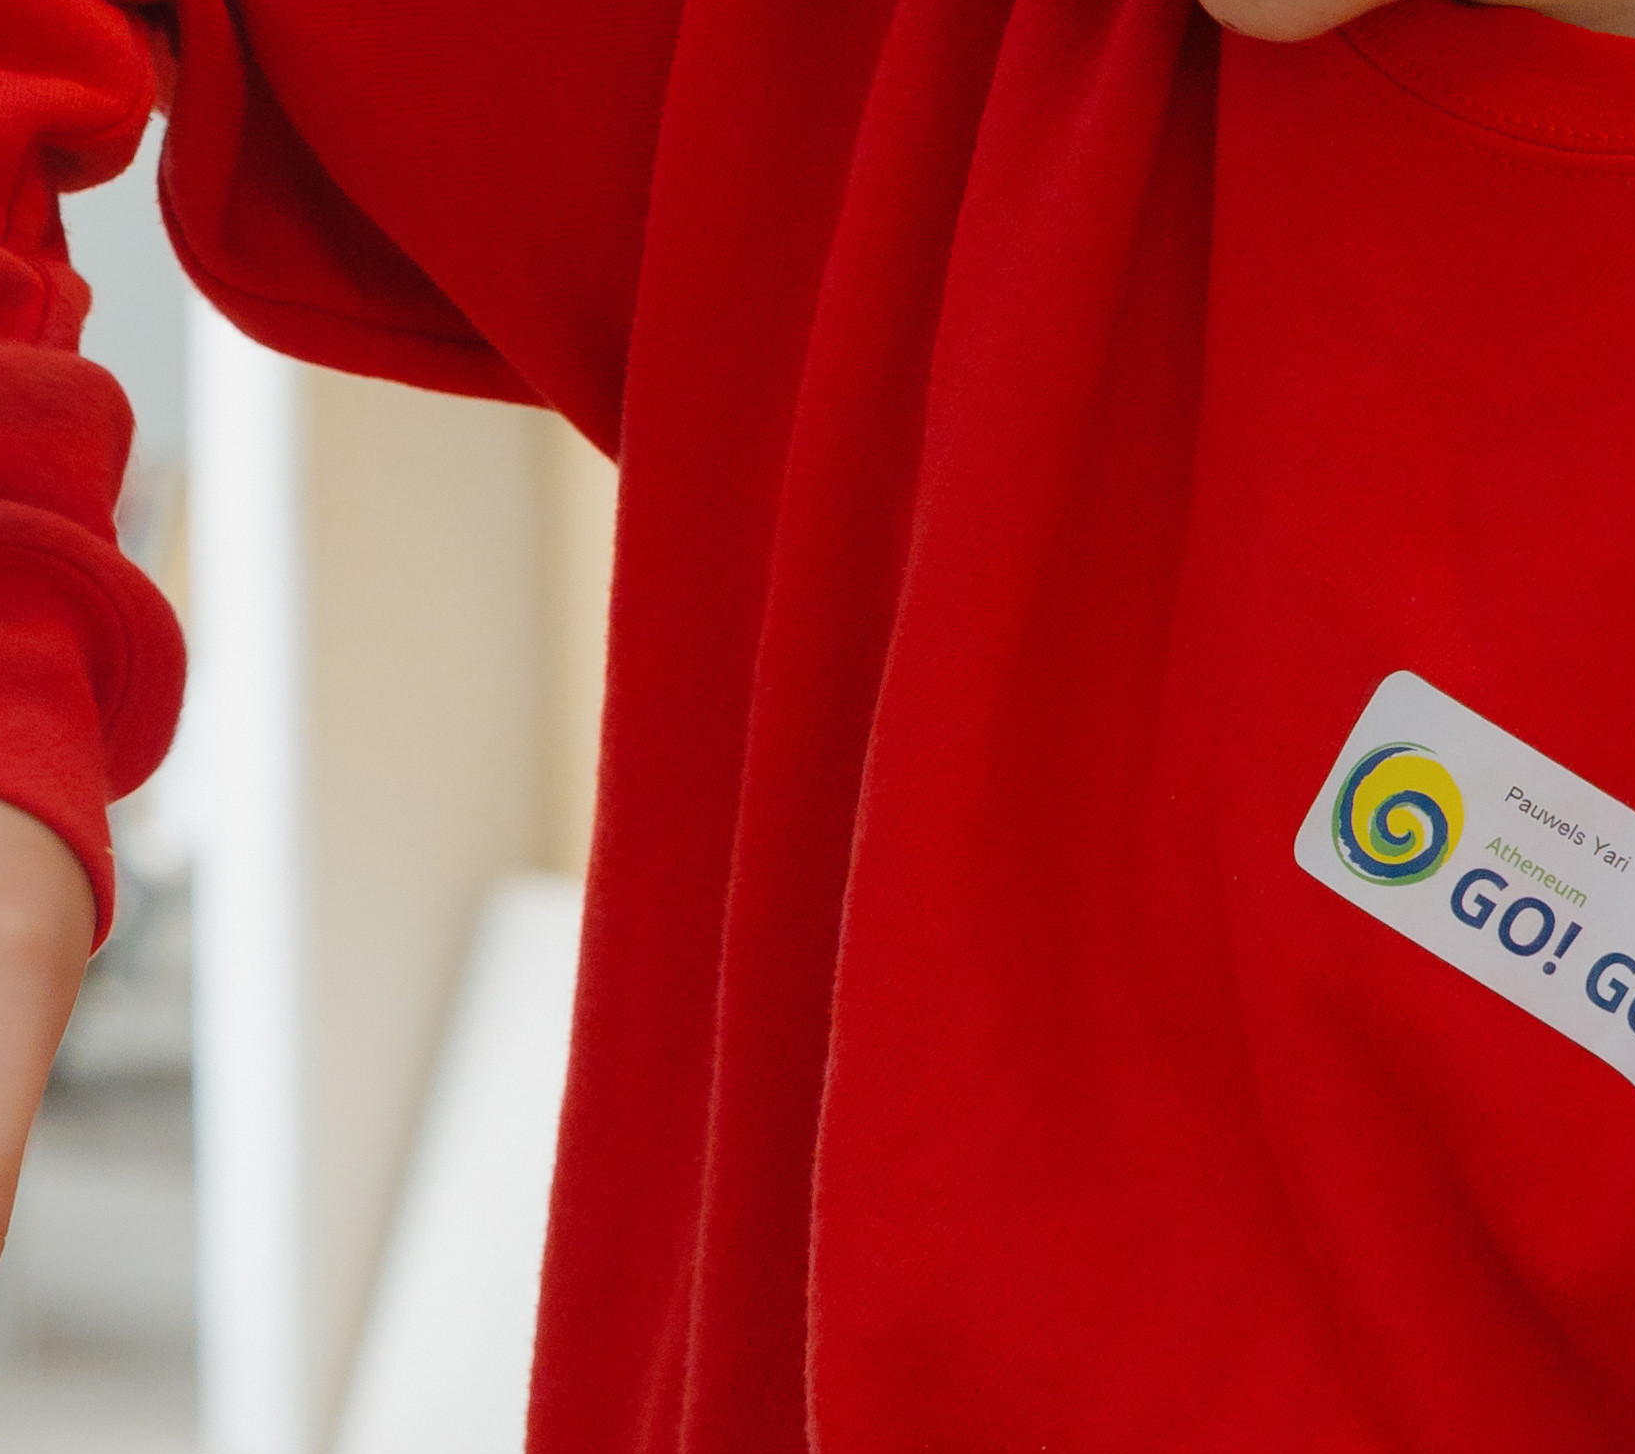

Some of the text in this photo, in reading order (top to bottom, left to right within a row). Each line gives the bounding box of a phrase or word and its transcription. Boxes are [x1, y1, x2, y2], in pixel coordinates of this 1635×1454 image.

[1484, 836, 1588, 908] Atheneum
[1504, 785, 1632, 873] Pauwels Yari
[1449, 867, 1584, 976] GO!
